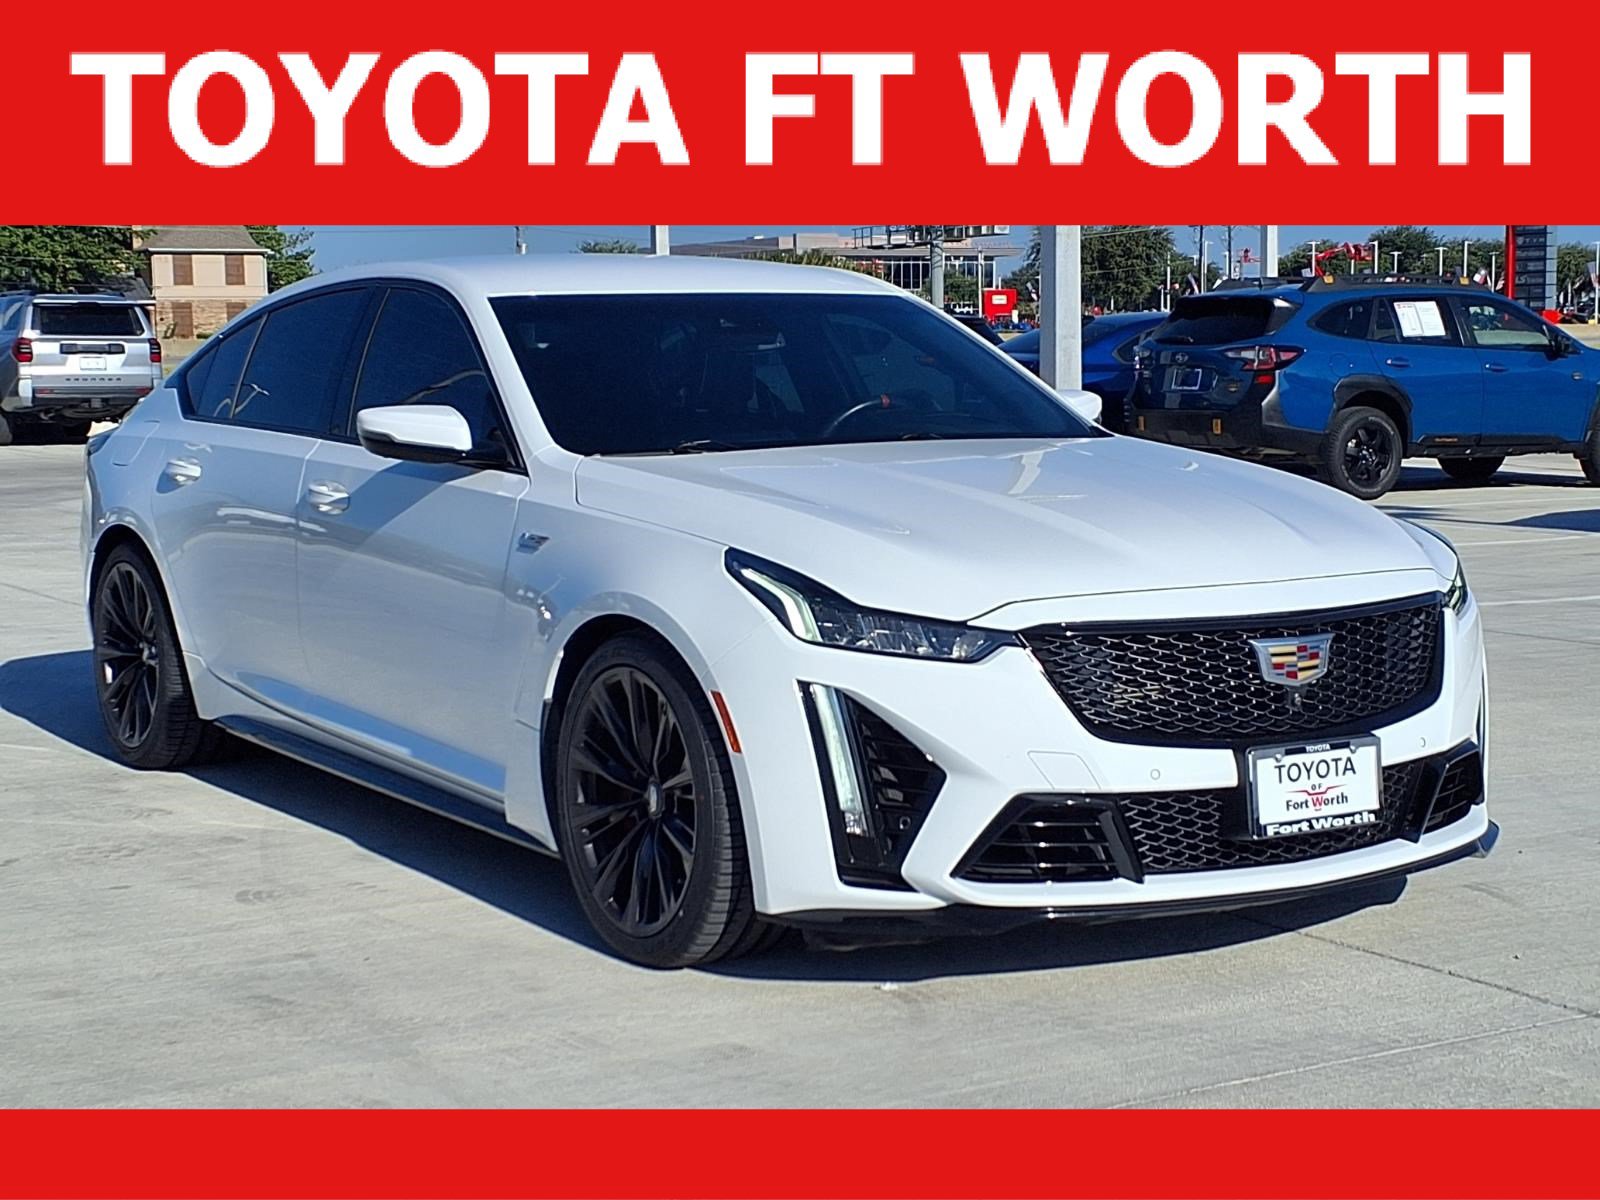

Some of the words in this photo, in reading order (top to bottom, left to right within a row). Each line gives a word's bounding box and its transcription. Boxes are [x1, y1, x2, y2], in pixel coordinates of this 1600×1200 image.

[1306, 744, 1330, 752] TOYOTA
[1274, 757, 1356, 784] TOYOTA
[1311, 783, 1322, 791] OF
[1286, 799, 1309, 811] Fort
[1311, 792, 1349, 808] Worth
[1266, 821, 1310, 836] Fort
[1311, 811, 1376, 830] Worth
